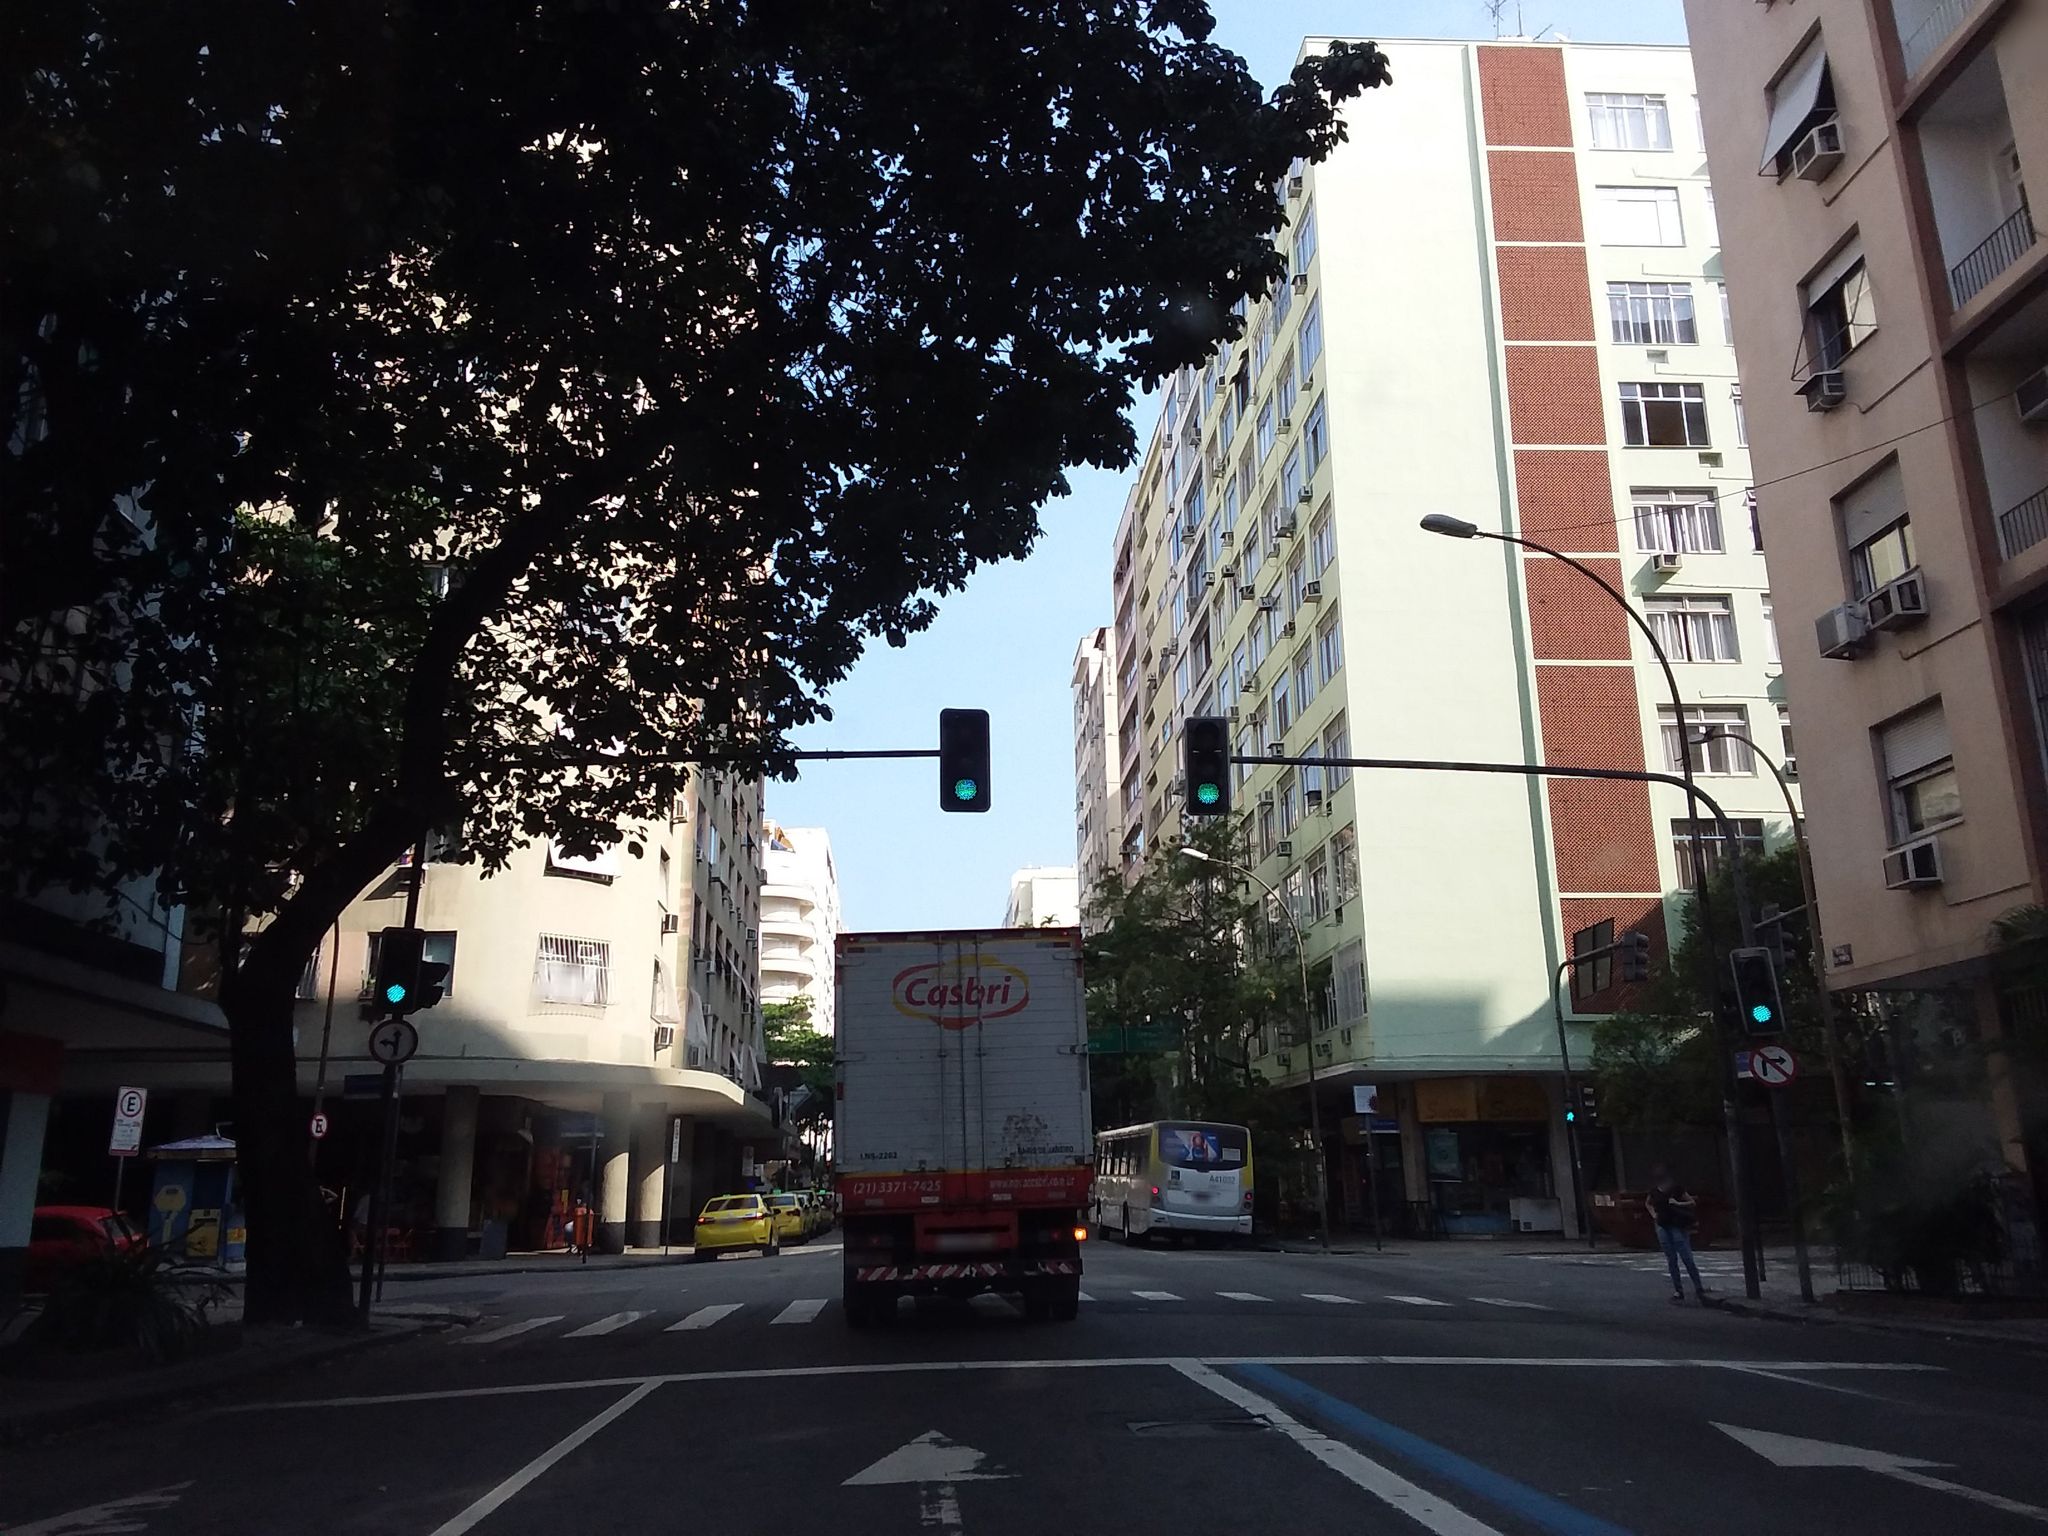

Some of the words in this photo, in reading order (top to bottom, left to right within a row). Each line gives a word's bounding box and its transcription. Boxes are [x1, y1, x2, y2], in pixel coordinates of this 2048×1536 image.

[904, 975, 1012, 1006] Casbri
[127, 1096, 137, 1112] E
[853, 1182, 876, 1196] (21)
